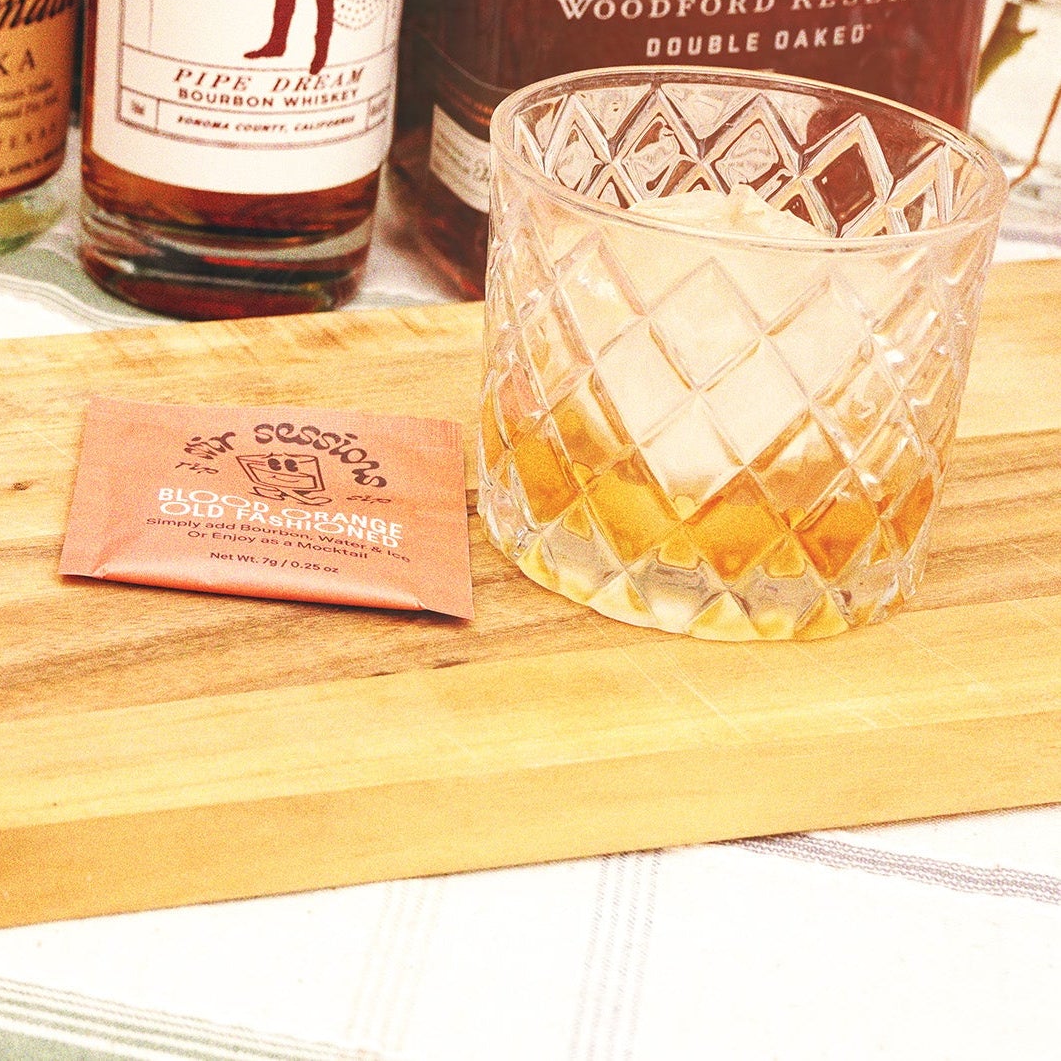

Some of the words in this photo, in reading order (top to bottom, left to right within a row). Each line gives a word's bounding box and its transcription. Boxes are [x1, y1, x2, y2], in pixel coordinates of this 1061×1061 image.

[646, 32, 760, 58] DOUBLE
[173, 68, 252, 91] PIPE
[272, 66, 366, 93] DREAM
[178, 88, 274, 107] BOURBON
[284, 89, 358, 107] WHISKEY
[177, 115, 230, 130] SONOMA
[253, 423, 388, 487] sessions
[158, 488, 269, 513] BLOOD
[282, 509, 403, 539] ORANGE
[160, 501, 224, 519] OLD
[236, 509, 399, 548] FASHIONED
[146, 518, 201, 529] Simply
[205, 521, 236, 530] add
[241, 524, 314, 540] Bourbon,
[318, 535, 372, 550] Water
[387, 550, 411, 563] Ice
[188, 531, 211, 539] Or
[213, 532, 256, 544] Enjoy
[260, 537, 279, 545] as
[298, 541, 369, 559] Mocktail
[210, 551, 234, 561] Net
[237, 554, 259, 564] Wt.
[262, 557, 278, 567] 7g
[291, 561, 321, 571] 0.25
